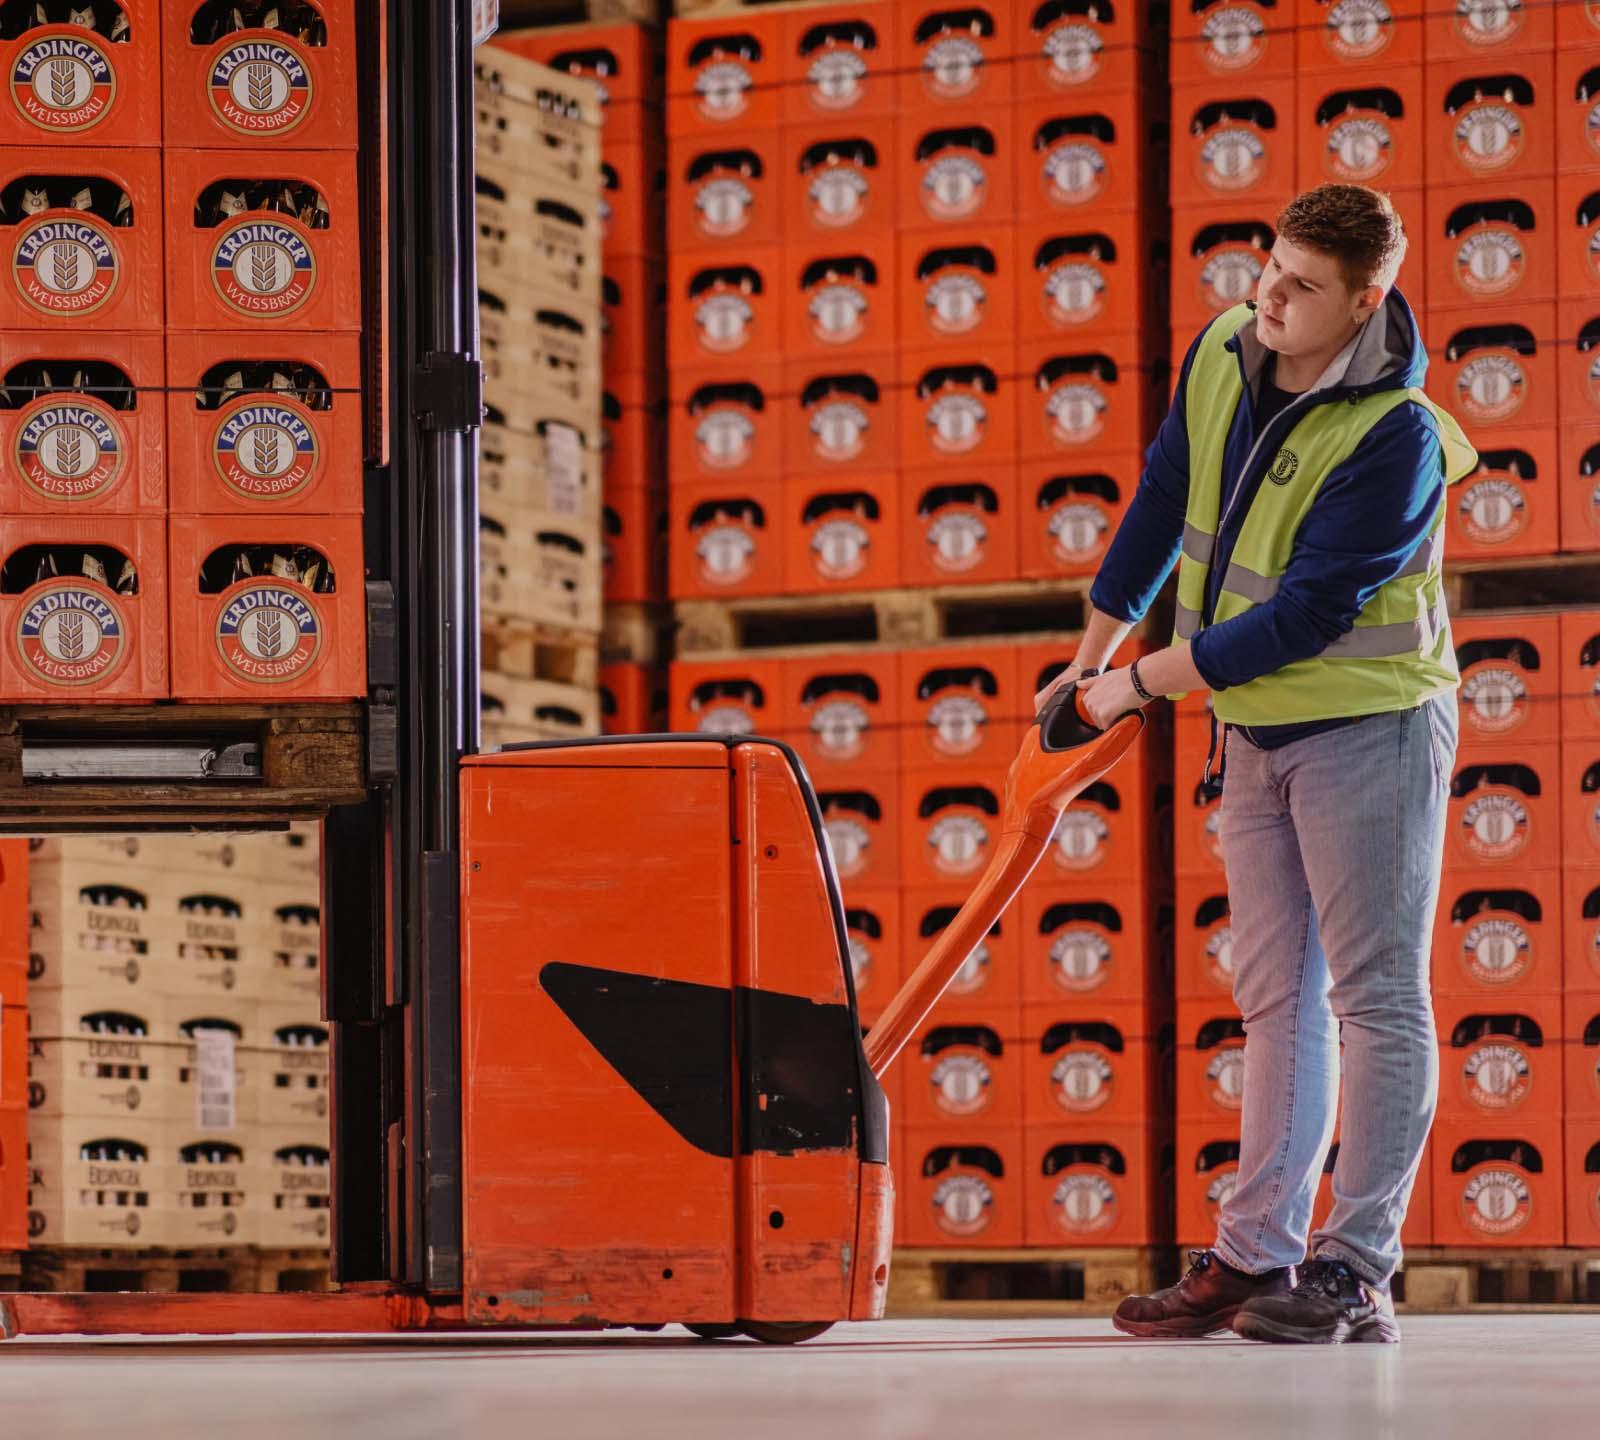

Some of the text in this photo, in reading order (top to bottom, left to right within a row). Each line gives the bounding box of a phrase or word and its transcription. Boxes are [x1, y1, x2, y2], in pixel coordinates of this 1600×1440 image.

[18, 40, 108, 77] ERDINGER
[213, 44, 304, 81] ERDINGER
[25, 96, 104, 125] WEISSBRÄU
[222, 100, 301, 128] WEISSBRÄU
[20, 224, 111, 261] ERDINGER
[218, 225, 308, 263] ERDINGER
[27, 281, 107, 309] WEISSBRÄU
[226, 282, 305, 310] WEISSBRÄU
[22, 408, 114, 446] ERDINGER
[219, 408, 311, 446] ERDINGER
[30, 465, 109, 494] WEISSBRÄU
[228, 465, 306, 493] WEISSBRÄU
[24, 592, 116, 629] ERDINGER
[222, 591, 313, 628] ERDINGER
[32, 649, 112, 678] WEISSBRÄU
[230, 648, 309, 677] WEISSBRÄU
